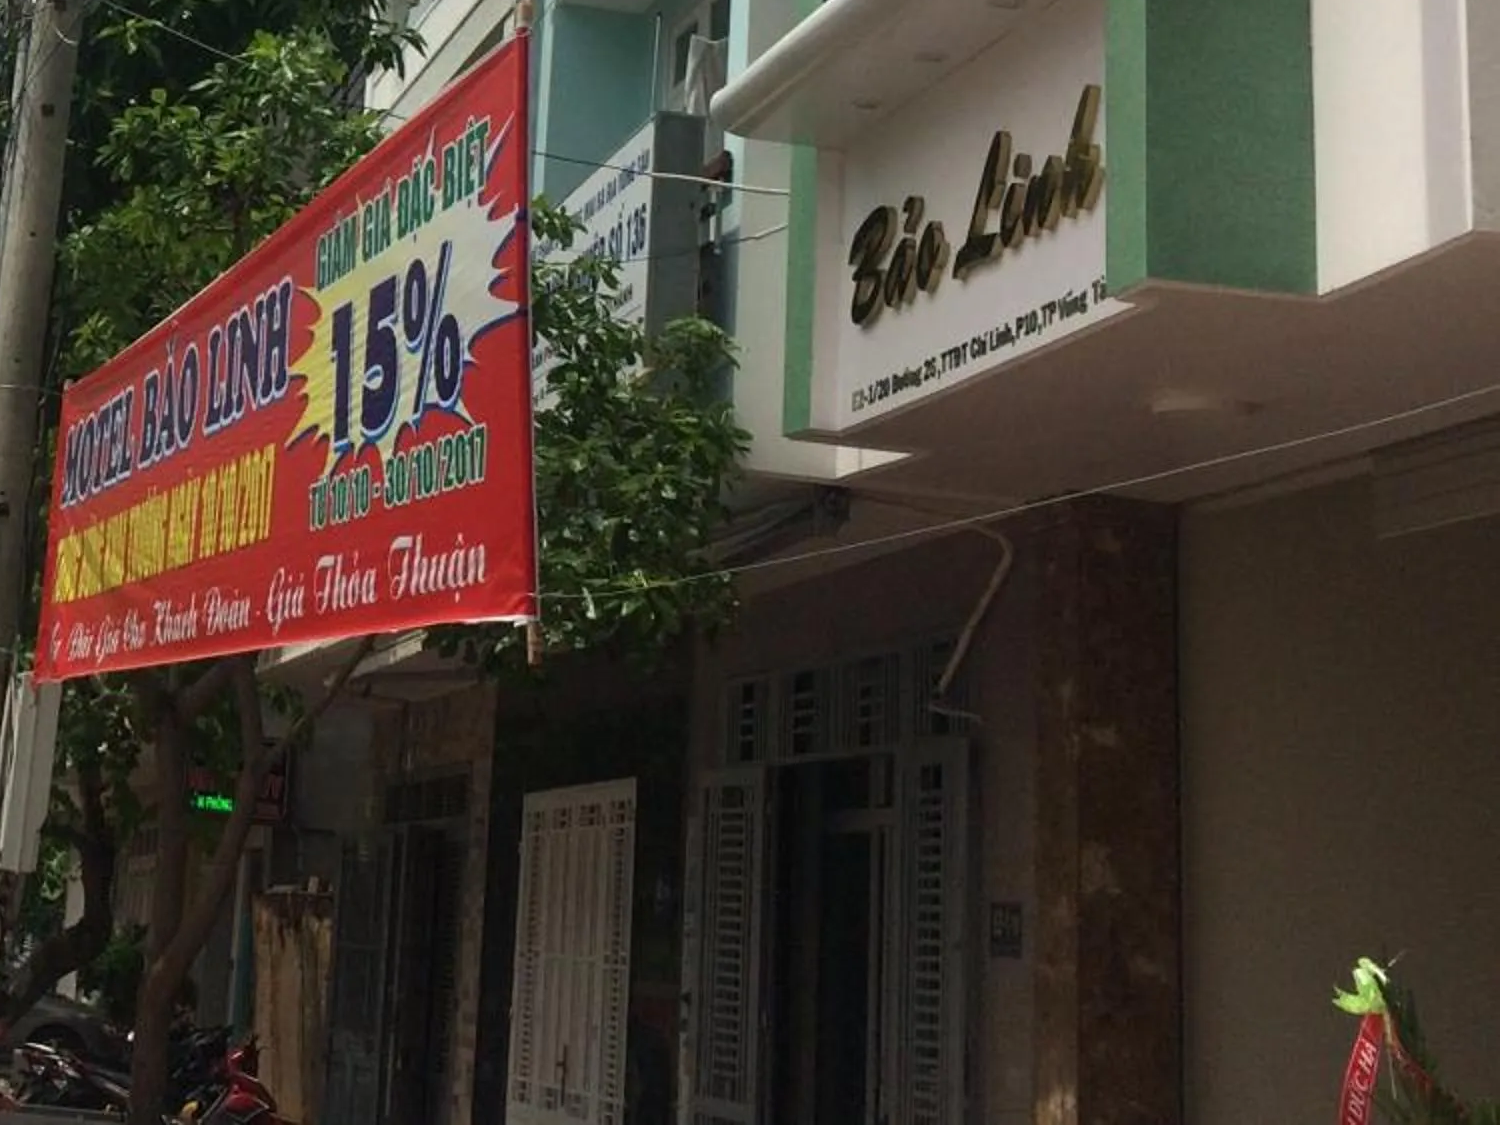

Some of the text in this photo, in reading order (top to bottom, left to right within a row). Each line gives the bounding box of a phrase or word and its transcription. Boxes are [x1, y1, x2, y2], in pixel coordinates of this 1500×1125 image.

[316, 115, 491, 292] GIẢM GIÁ ĐẶC BIỆT
[848, 84, 1105, 325] Bảo Linh
[61, 275, 293, 509] HOTEL BẢO LINH
[330, 241, 467, 455] 15%
[384, 423, 488, 508] 30/10/2017
[265, 566, 304, 637] Giá
[314, 551, 378, 615] Thỏa
[387, 531, 486, 604] Thuận
